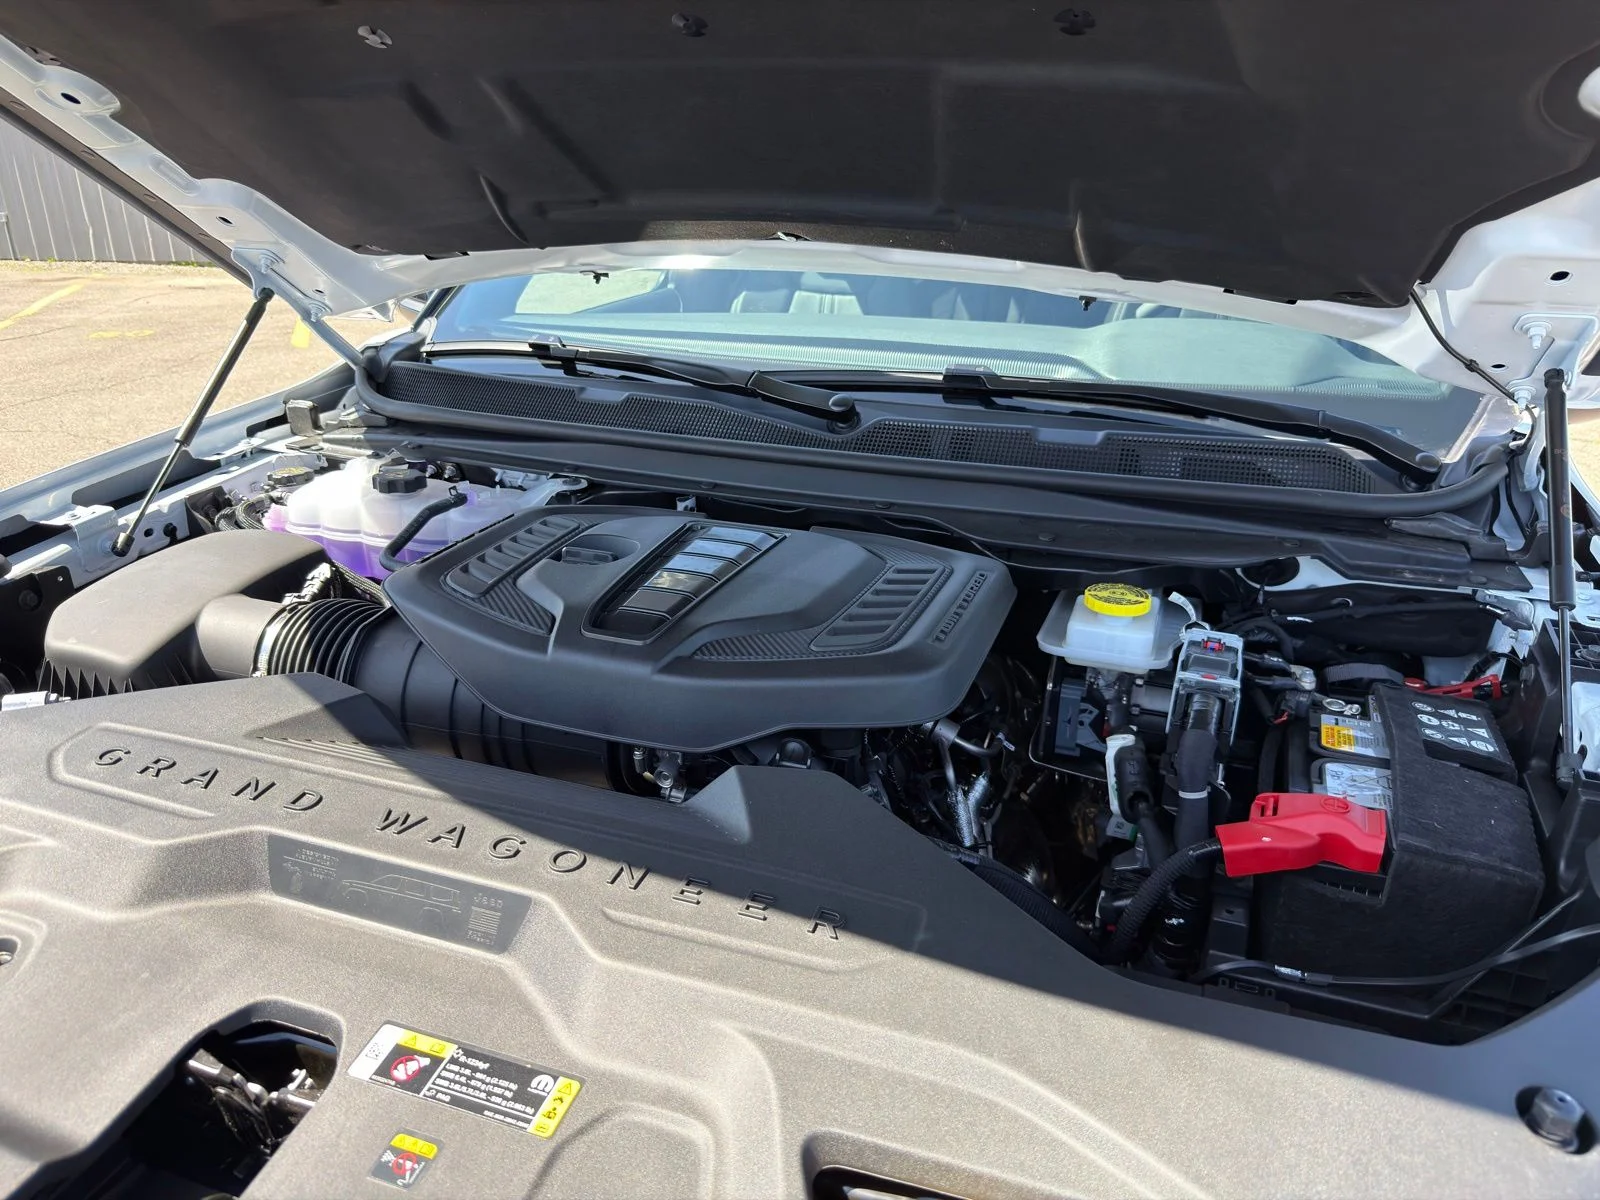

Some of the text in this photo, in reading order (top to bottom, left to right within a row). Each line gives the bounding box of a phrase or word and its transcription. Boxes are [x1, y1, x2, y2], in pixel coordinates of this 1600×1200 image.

[934, 571, 988, 642] TWIN TURBO
[94, 748, 847, 940] GRAND WAGONEER
